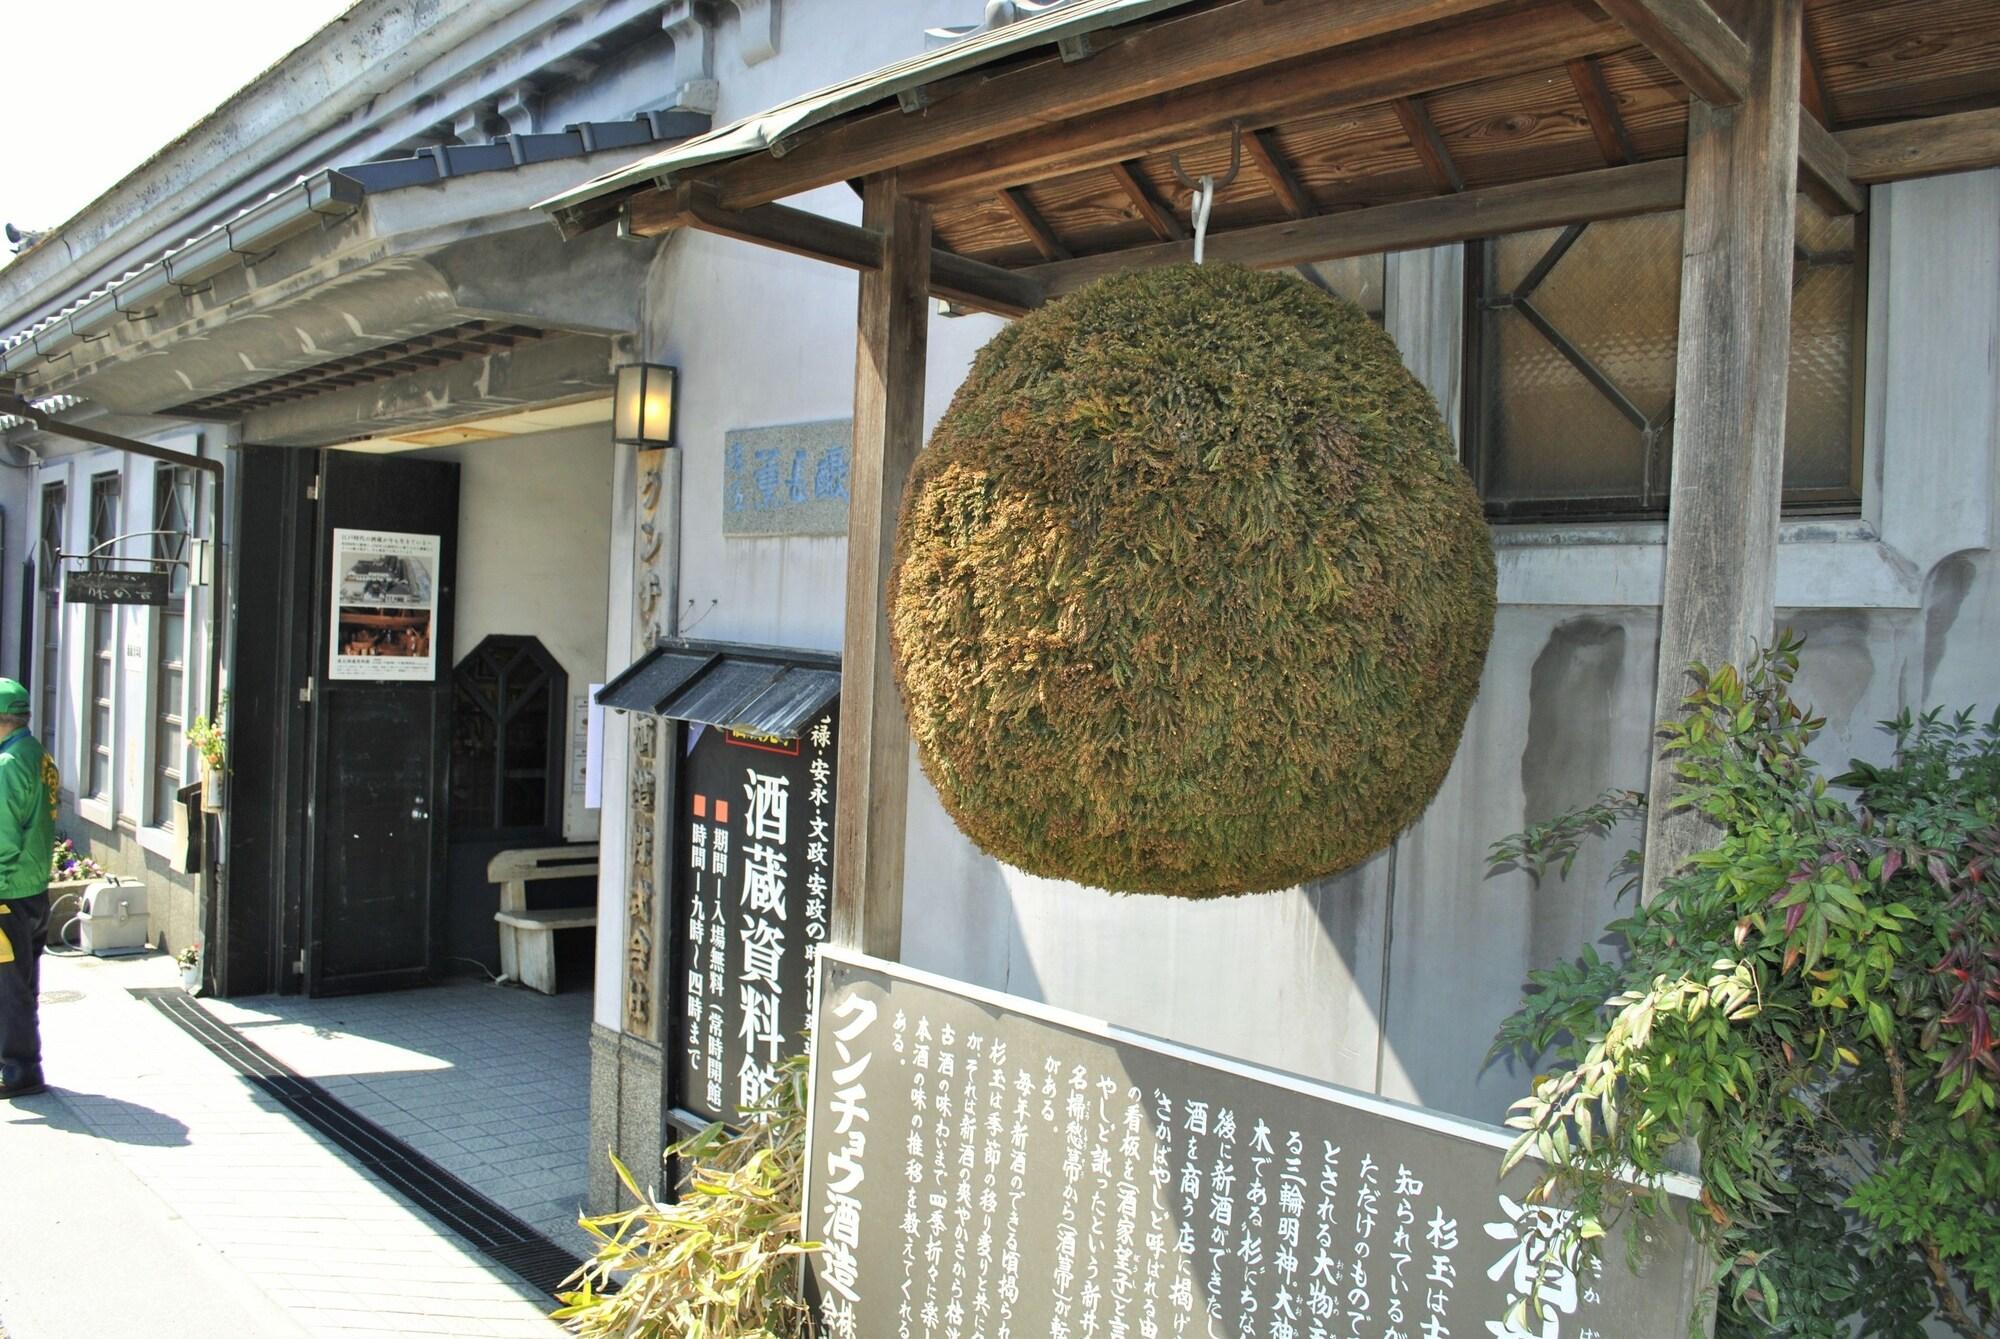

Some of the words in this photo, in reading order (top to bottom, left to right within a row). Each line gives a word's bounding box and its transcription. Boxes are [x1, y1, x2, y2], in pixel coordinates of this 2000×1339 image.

[1168, 1099, 1209, 1339] 酒を商う店に掲げ
[1347, 1153, 1382, 1339] ただけのもので
